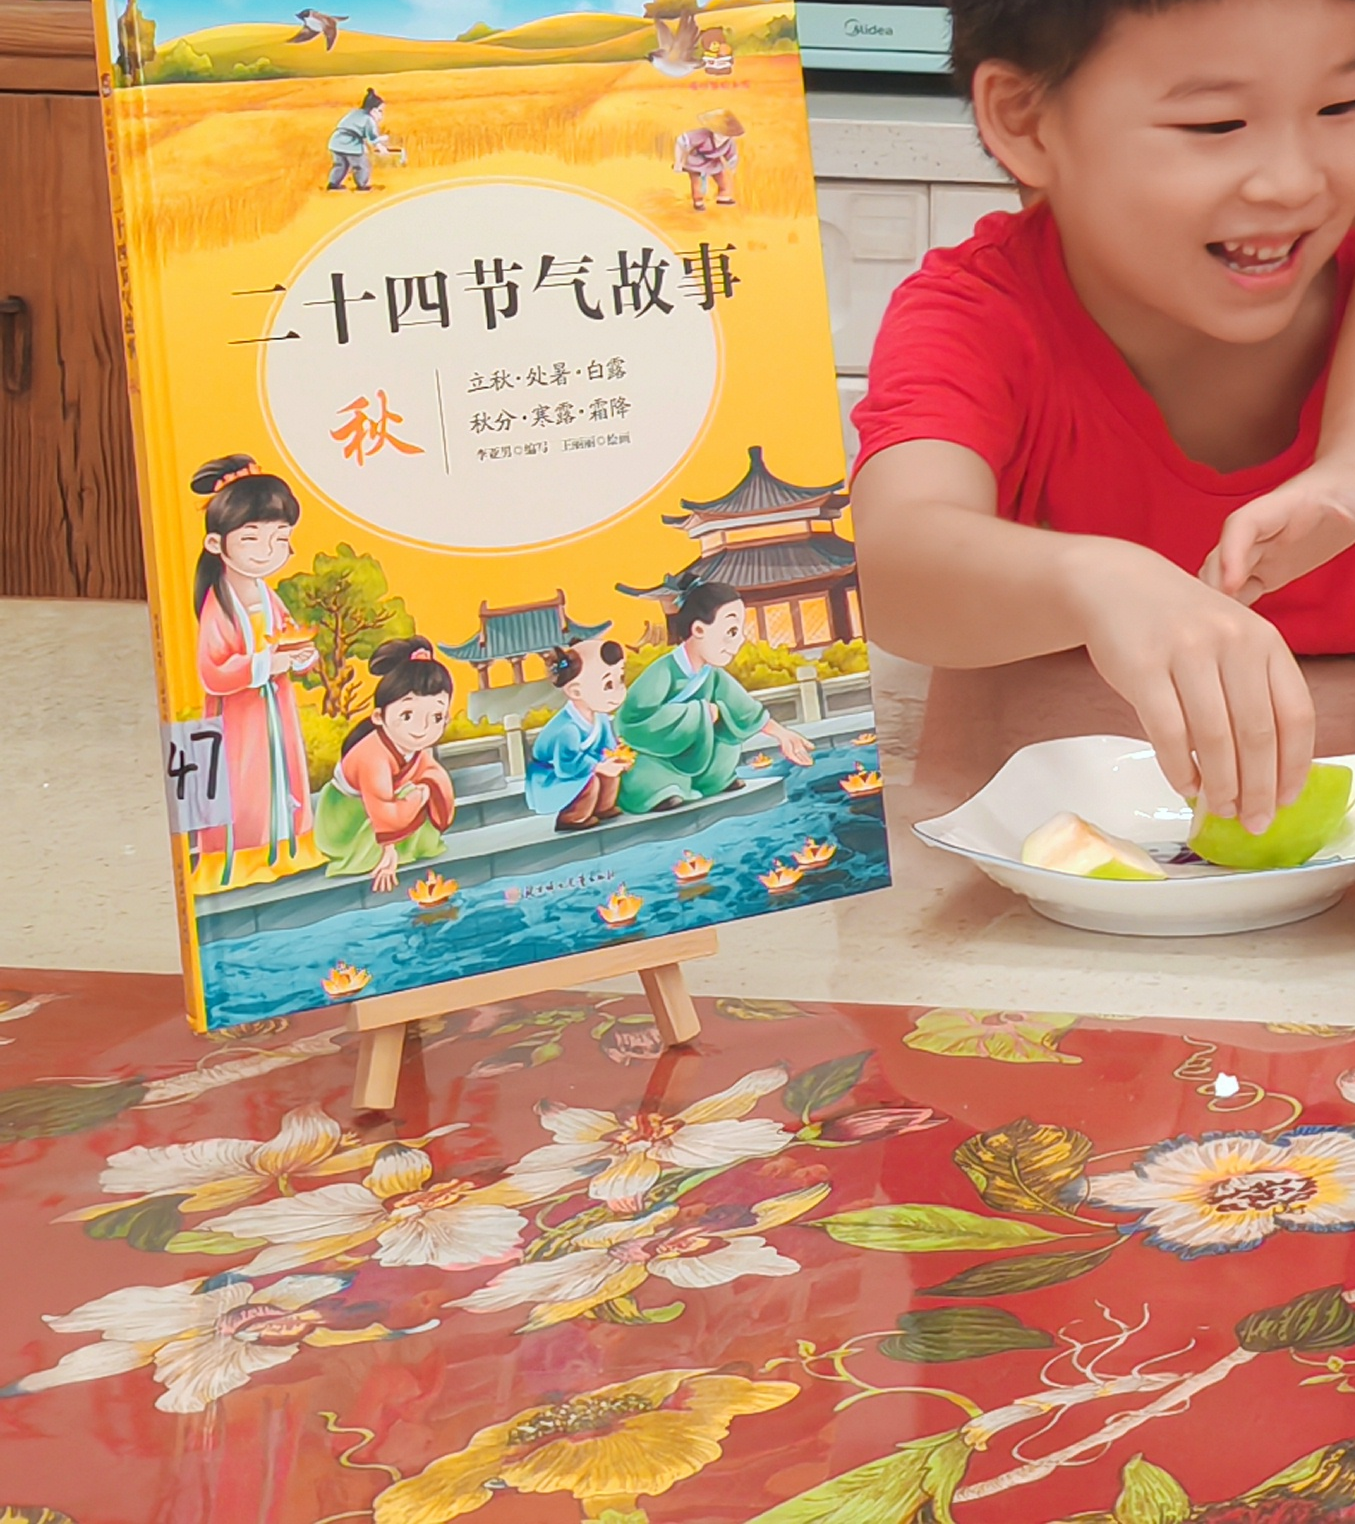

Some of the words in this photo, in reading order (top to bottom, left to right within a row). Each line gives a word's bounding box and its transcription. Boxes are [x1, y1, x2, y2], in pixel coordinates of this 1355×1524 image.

[844, 18, 894, 38] Midea
[228, 242, 742, 347] 二十四节气故事
[330, 388, 425, 467] 秋
[167, 730, 223, 802] 47
